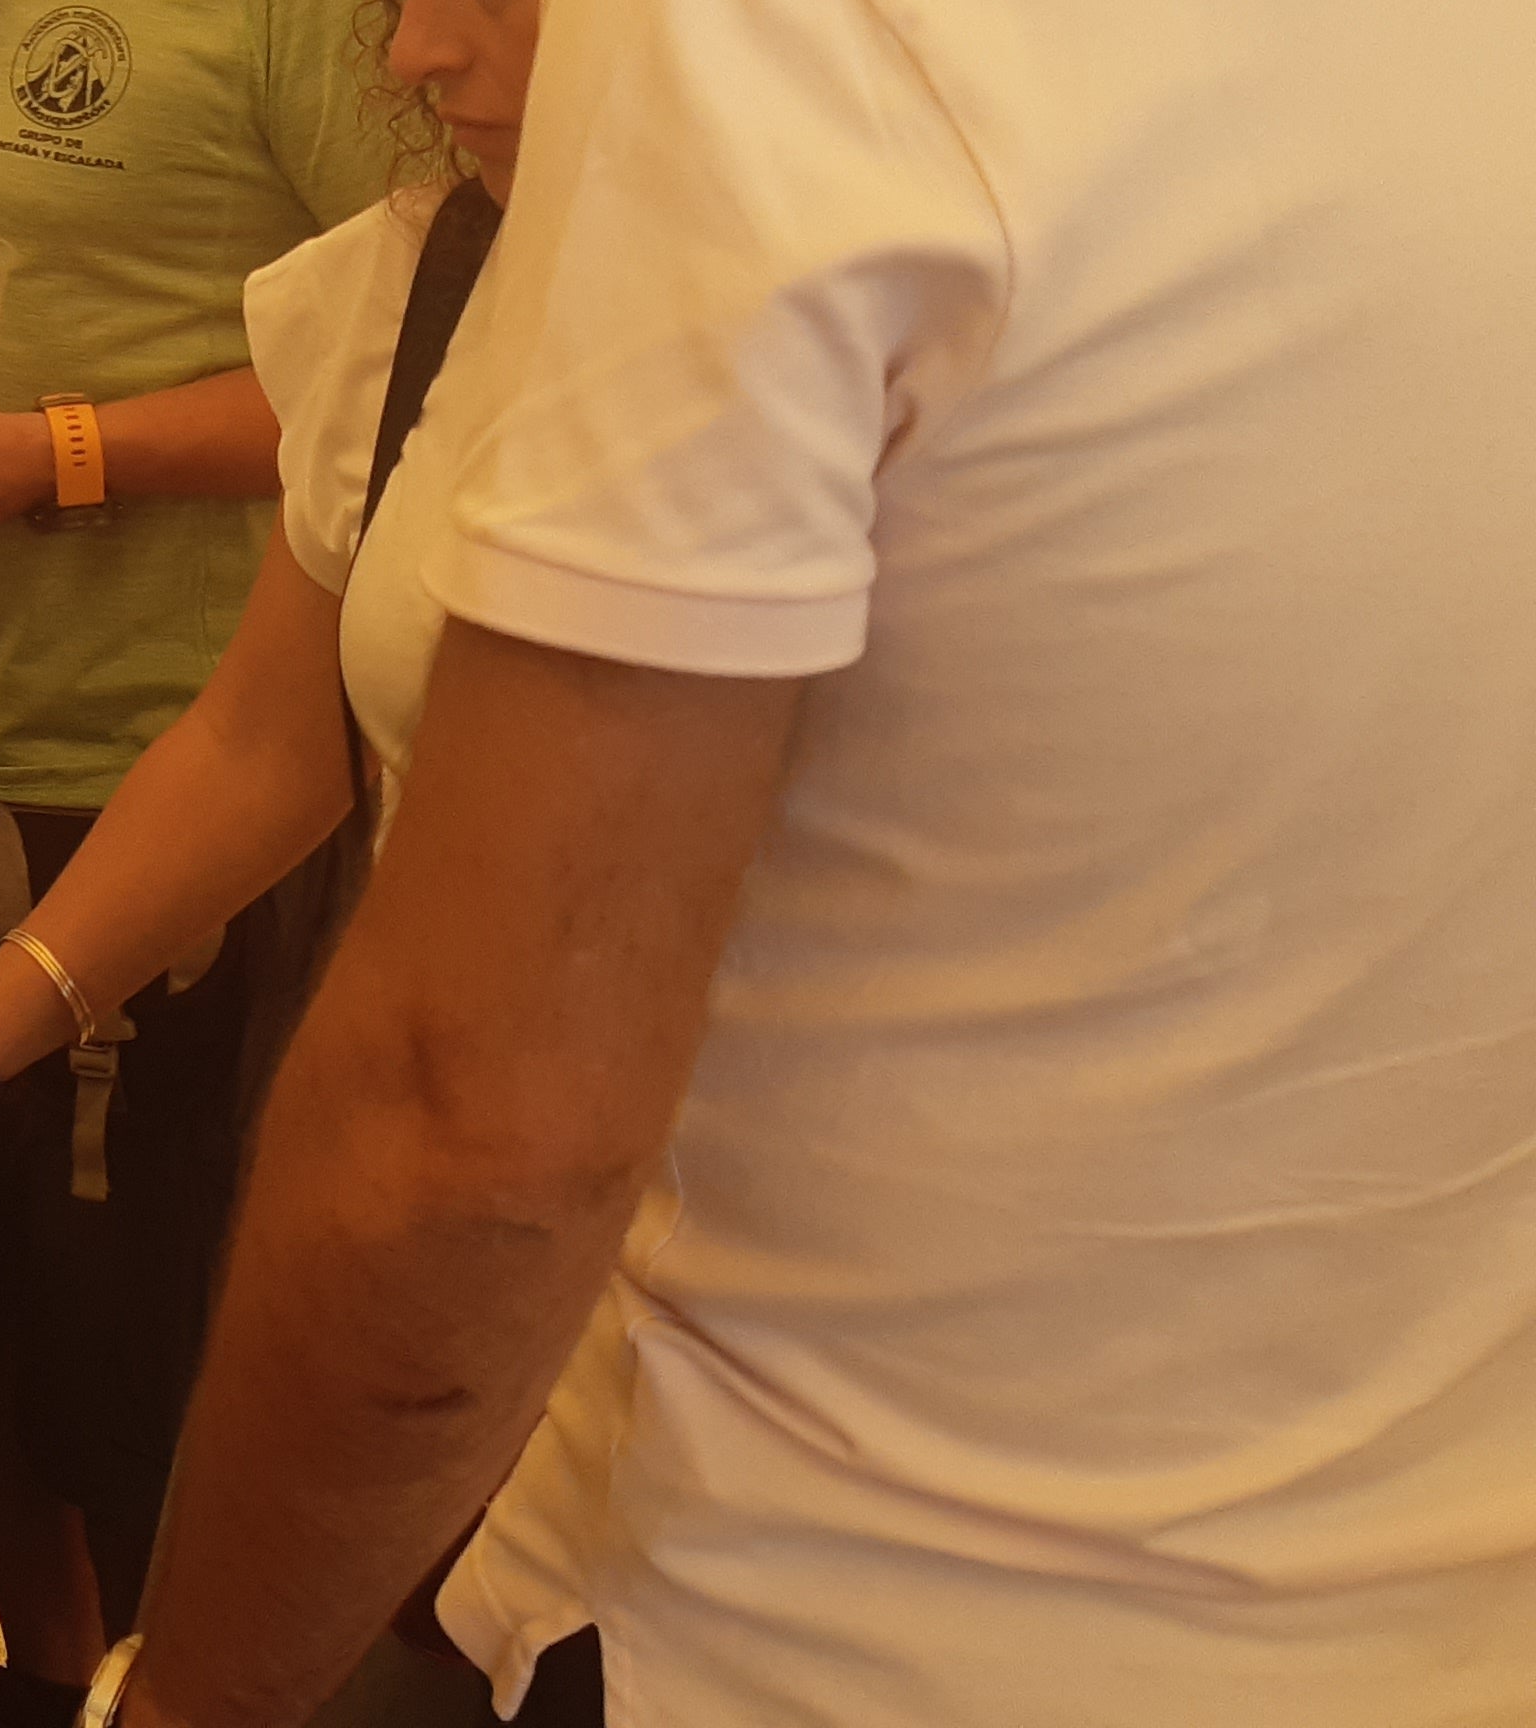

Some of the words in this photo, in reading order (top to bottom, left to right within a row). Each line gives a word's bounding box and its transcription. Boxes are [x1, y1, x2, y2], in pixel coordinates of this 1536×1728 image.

[18, 129, 62, 145] GRUPO
[64, 138, 84, 149] DE
[42, 149, 52, 159] Y
